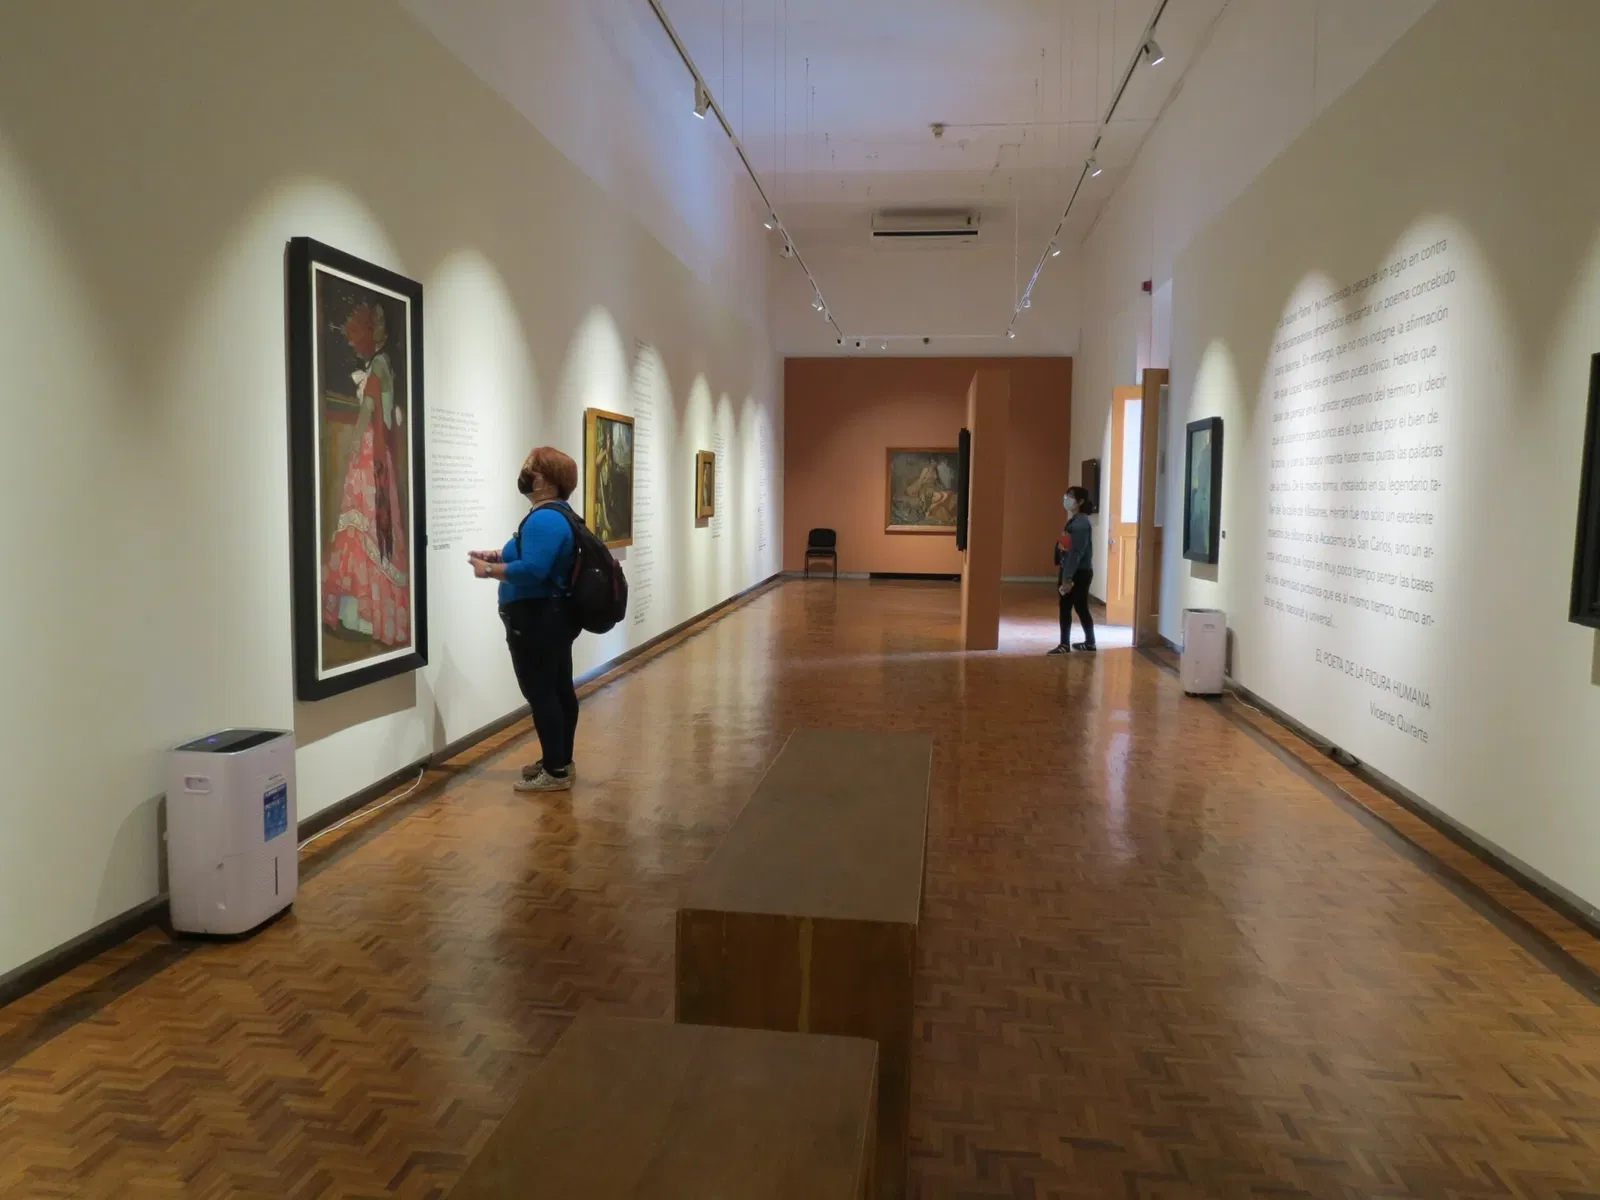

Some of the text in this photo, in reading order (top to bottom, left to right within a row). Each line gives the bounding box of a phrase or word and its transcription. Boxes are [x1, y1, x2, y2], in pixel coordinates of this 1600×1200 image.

[1389, 256, 1407, 279] siglo
[1409, 252, 1419, 267] en
[1421, 239, 1447, 261] contra
[1374, 299, 1383, 313] un
[1384, 289, 1410, 312] poema
[1412, 265, 1455, 298] concebido
[1335, 343, 1347, 361] que
[1348, 340, 1356, 351] no
[1357, 334, 1369, 349] nos
[1370, 325, 1396, 345] indigne
[1396, 316, 1404, 334] la
[1405, 304, 1449, 332] afirmación
[1351, 363, 1369, 384] poeta
[1393, 346, 1419, 367] Habría
[1420, 345, 1437, 364] que
[1374, 384, 1386, 402] del
[1387, 381, 1416, 399] término
[1417, 380, 1423, 398] y
[1424, 372, 1447, 392] decir
[1352, 422, 1364, 439] que
[1366, 416, 1383, 433] lucha
[1384, 417, 1398, 436] por
[1399, 411, 1407, 428] el
[1407, 411, 1426, 427] bien
[1427, 408, 1440, 424] de
[1361, 448, 1375, 462] más
[1375, 449, 1396, 466] puras
[1397, 443, 1408, 461] las
[1408, 440, 1443, 464] palabras
[1368, 479, 1377, 491] en
[1378, 480, 1387, 491] su
[1388, 474, 1429, 496] legendario
[1430, 478, 1442, 491] ta-
[1349, 504, 1360, 520] fue
[1360, 510, 1370, 521] no
[1370, 505, 1385, 521] sólo
[1386, 511, 1396, 522] un
[1396, 508, 1434, 525] excelente
[1319, 531, 1347, 547] Academia
[1348, 532, 1357, 549] de
[1357, 534, 1369, 551] San
[1370, 536, 1393, 556] Carlos,
[1395, 541, 1410, 556] sino
[1411, 545, 1421, 557] un
[1423, 545, 1435, 559] ar-
[1324, 561, 1336, 580] muy
[1337, 563, 1352, 580] poco
[1353, 565, 1375, 585] tiempo
[1376, 571, 1399, 586] sentar
[1400, 571, 1410, 588] las
[1411, 573, 1434, 592] bases
[1323, 588, 1334, 605] que
[1334, 591, 1342, 604] es
[1342, 591, 1349, 605] al
[1349, 594, 1370, 611] mismo
[1371, 599, 1396, 621] tiempo,
[1398, 607, 1420, 624] como
[1421, 612, 1436, 627] an-
[1315, 648, 1431, 711] EL POETA DE LA FIGURA HUMANA
[1369, 700, 1429, 744] Vicente Quirarte
